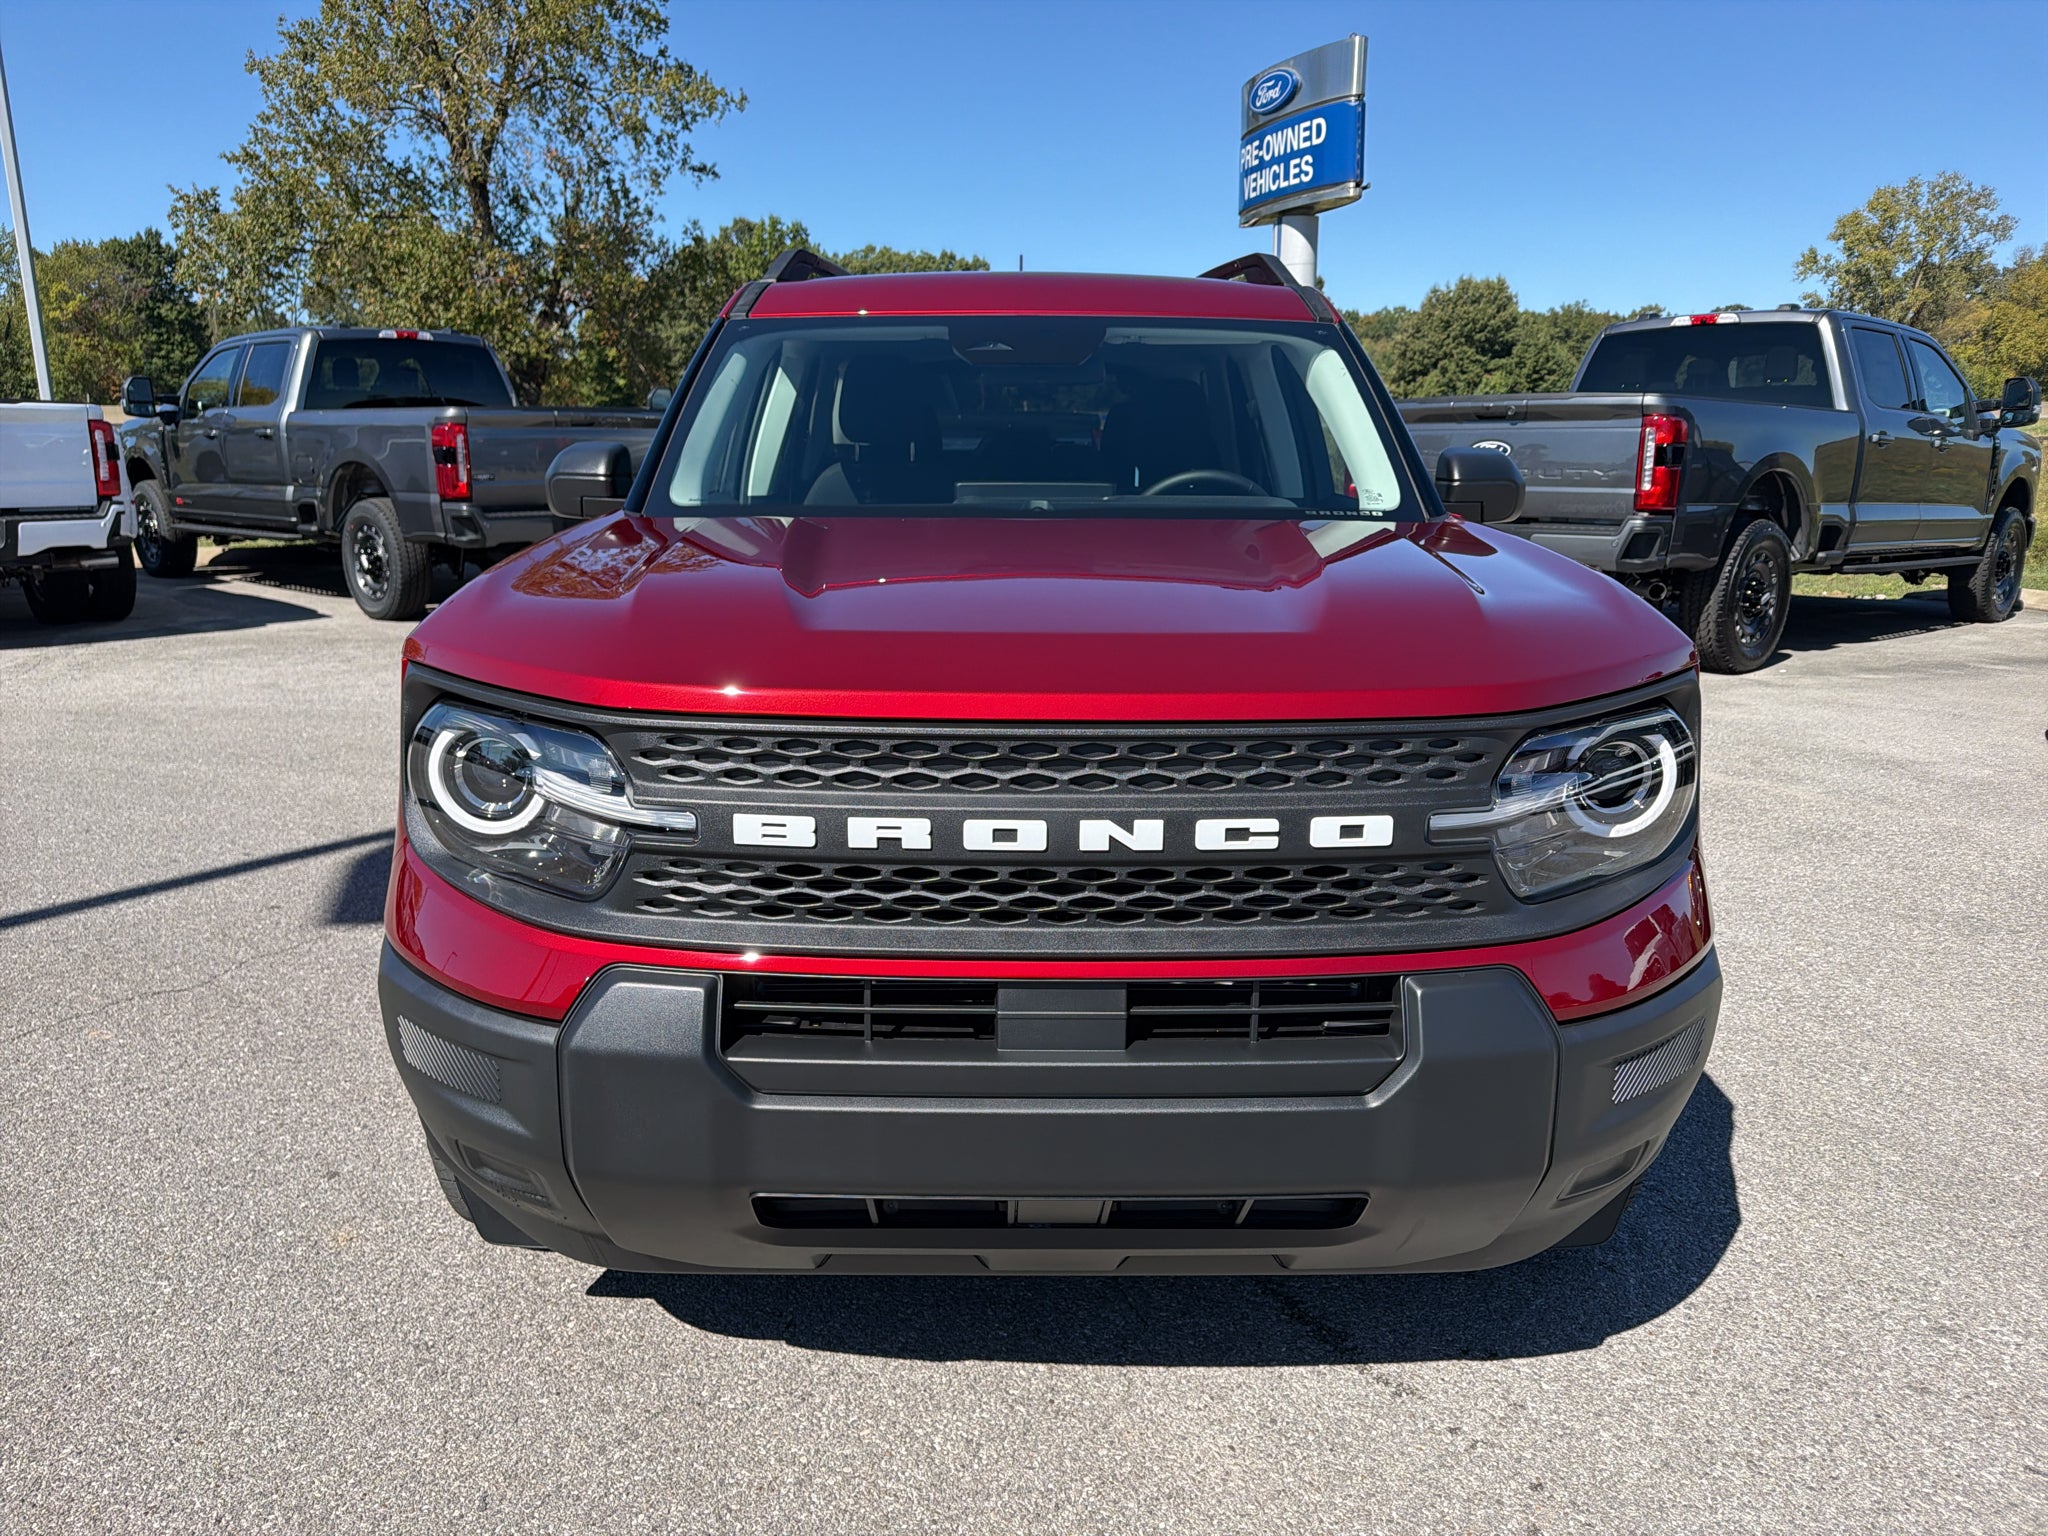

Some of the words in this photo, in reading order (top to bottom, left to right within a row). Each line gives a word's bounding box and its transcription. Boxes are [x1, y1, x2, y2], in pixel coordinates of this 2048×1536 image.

[1255, 79, 1283, 107] Ford
[1240, 117, 1327, 172] PRE-OWNED
[1243, 154, 1314, 201] VEHICLES
[732, 812, 1394, 853] BRONCO
